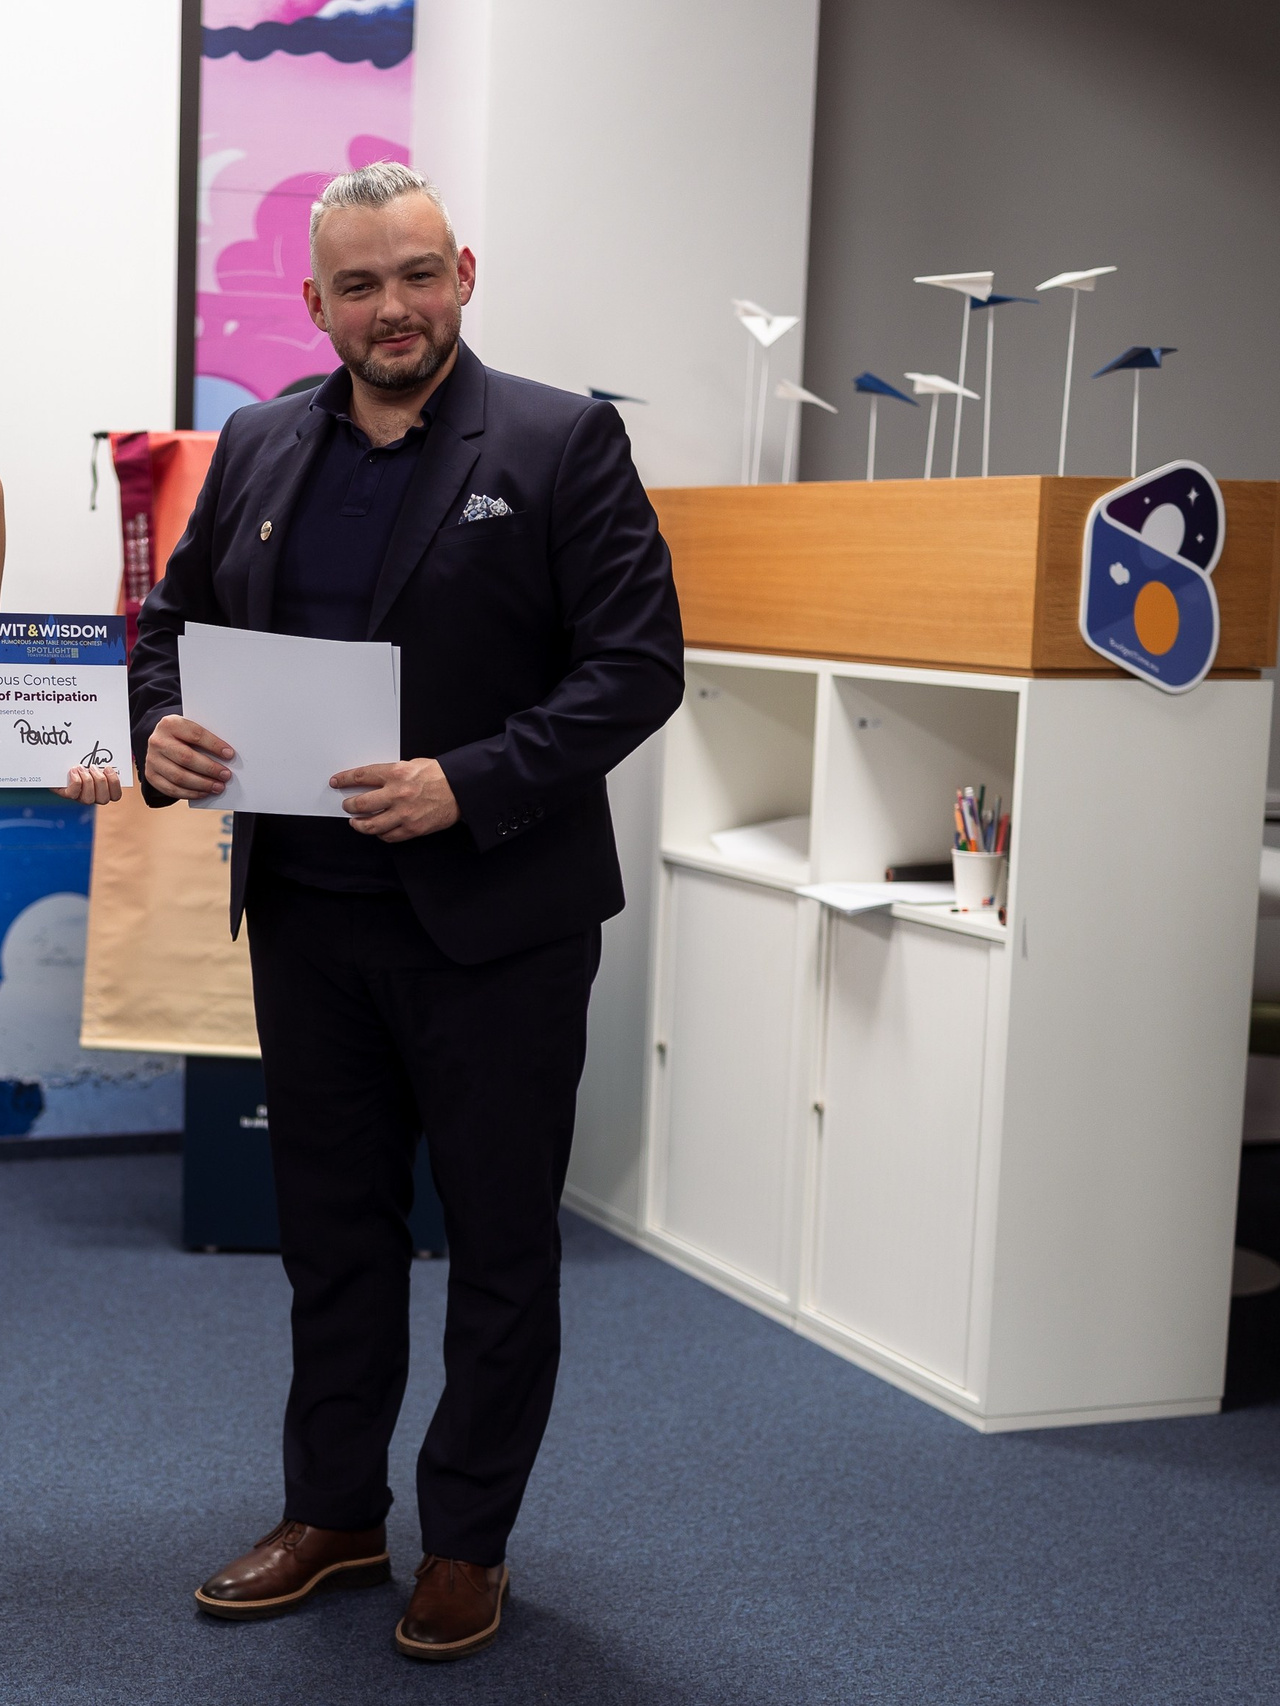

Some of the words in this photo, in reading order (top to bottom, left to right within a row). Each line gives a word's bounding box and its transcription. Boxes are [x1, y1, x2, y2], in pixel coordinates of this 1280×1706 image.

[26, 646, 71, 654] SPOTLIGHT
[23, 674, 77, 687] Contest
[14, 690, 98, 704] Participation
